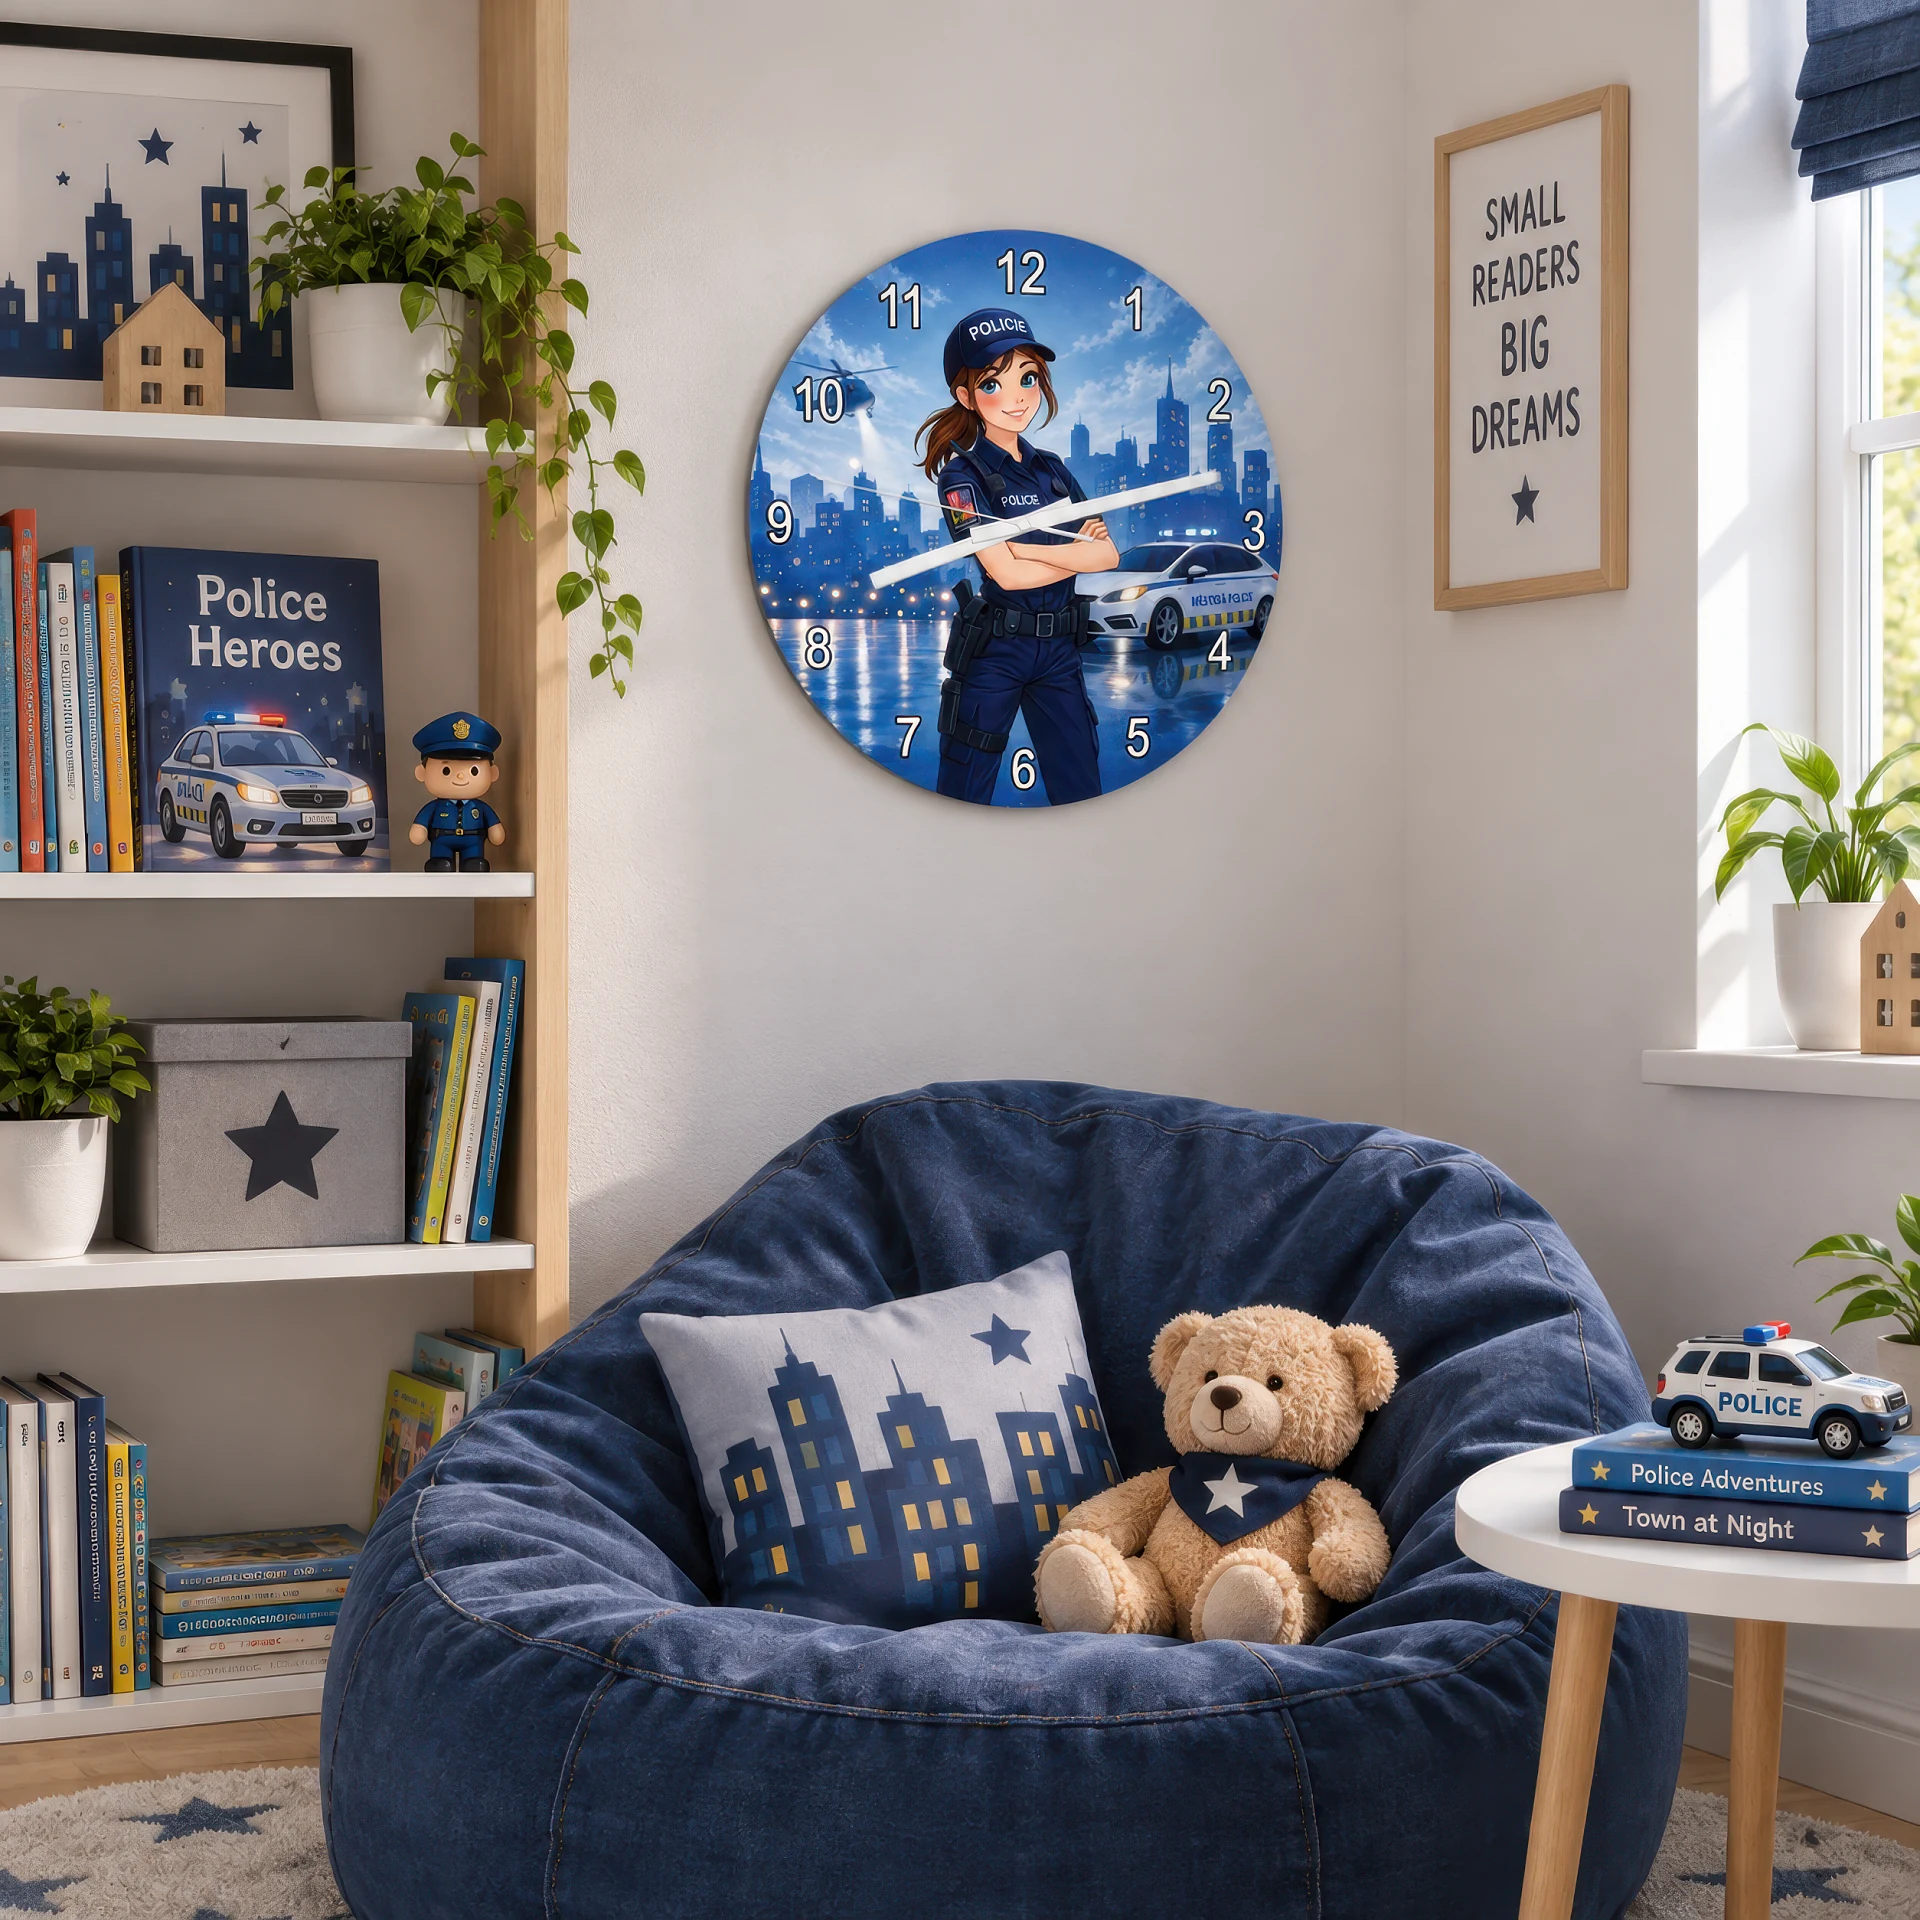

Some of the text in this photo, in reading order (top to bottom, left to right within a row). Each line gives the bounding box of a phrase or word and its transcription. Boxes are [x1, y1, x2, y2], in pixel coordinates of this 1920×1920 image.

[1485, 180, 1566, 241] SMALL
[996, 249, 1047, 296] 12
[1472, 239, 1580, 307] READERS
[879, 283, 922, 329] 11
[1125, 287, 1143, 330] 1
[969, 318, 1027, 341] POLICIE
[1501, 315, 1550, 377] BIG
[794, 377, 844, 423] 10
[1208, 378, 1232, 423] 2
[1471, 386, 1581, 454] DREAMS
[767, 500, 793, 545] 9
[1243, 509, 1266, 553] 3
[197, 574, 327, 623] Police
[188, 623, 342, 672] Heroes
[805, 626, 832, 670] 8
[1207, 629, 1232, 671] 4
[896, 716, 921, 758] 7
[1126, 717, 1150, 759] 5
[1012, 749, 1036, 791] 6
[1718, 1391, 1802, 1417] POLICE
[1631, 1464, 1824, 1496] Police Adventures
[1622, 1505, 1795, 1543] Town at Night
